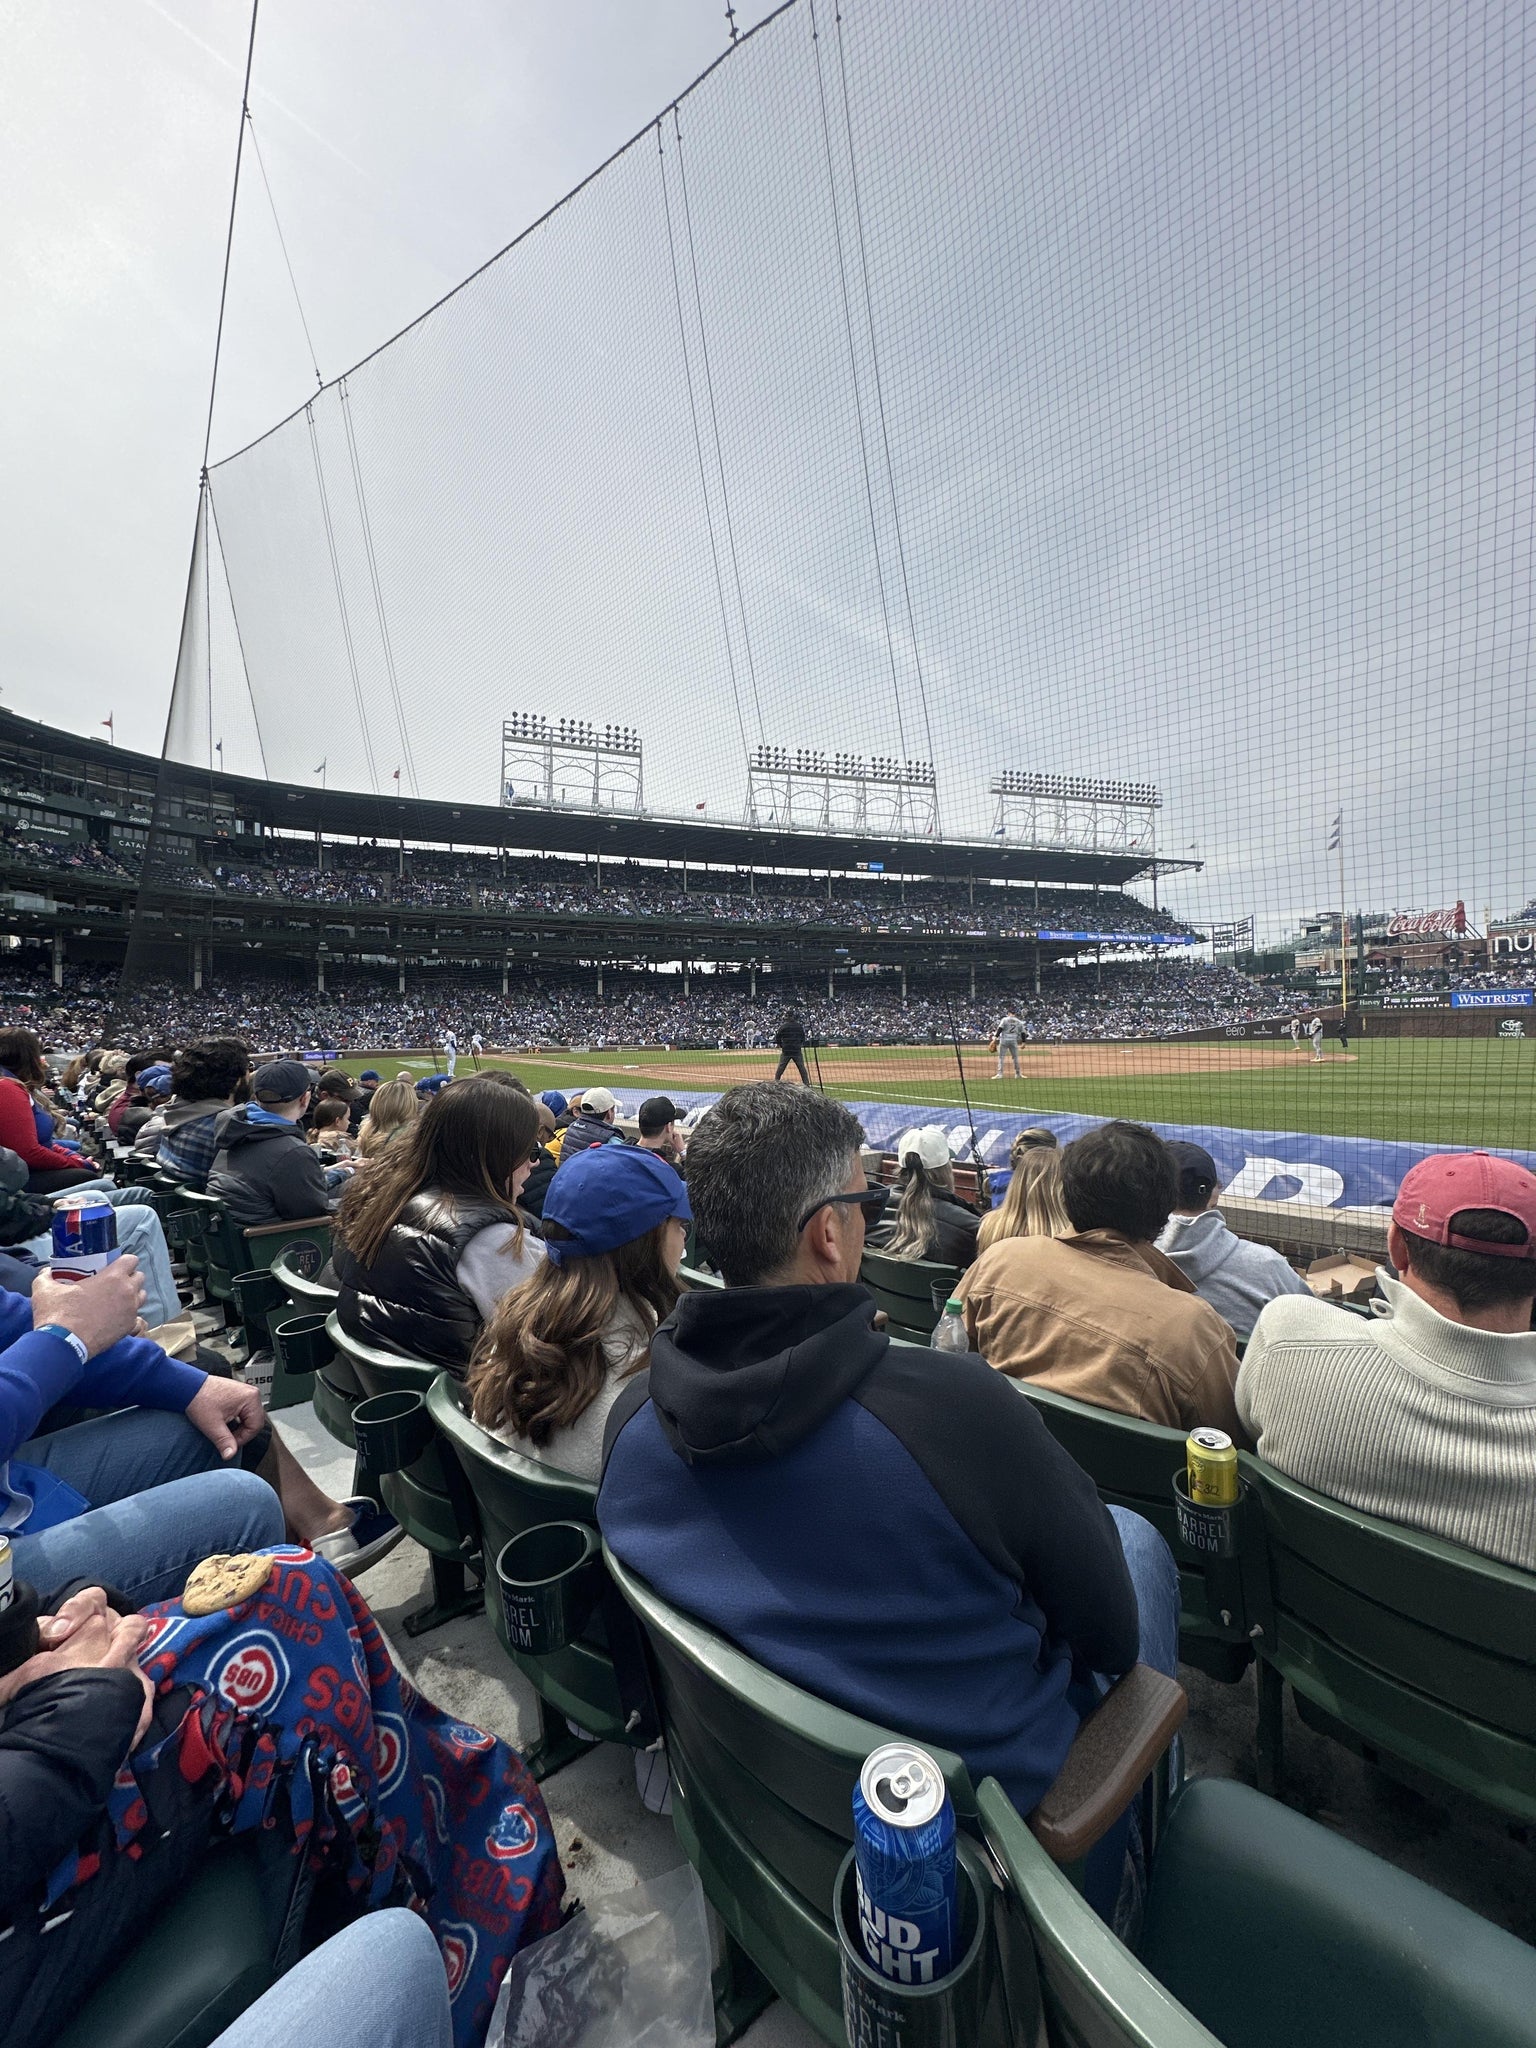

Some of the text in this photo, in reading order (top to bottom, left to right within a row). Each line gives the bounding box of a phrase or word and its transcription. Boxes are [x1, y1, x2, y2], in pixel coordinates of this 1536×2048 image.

[30, 824, 70, 836] JamesHardie
[119, 840, 190, 856] CATALA CLUB
[1387, 911, 1457, 937] Coca-Cola
[1457, 994, 1528, 1006] WINTRUST
[1009, 1025, 1016, 1034] 2
[1225, 1026, 1246, 1037] eero
[347, 1078, 355, 1088] P
[1176, 1506, 1226, 1538] BARREL
[1181, 1525, 1219, 1553] ROOM
